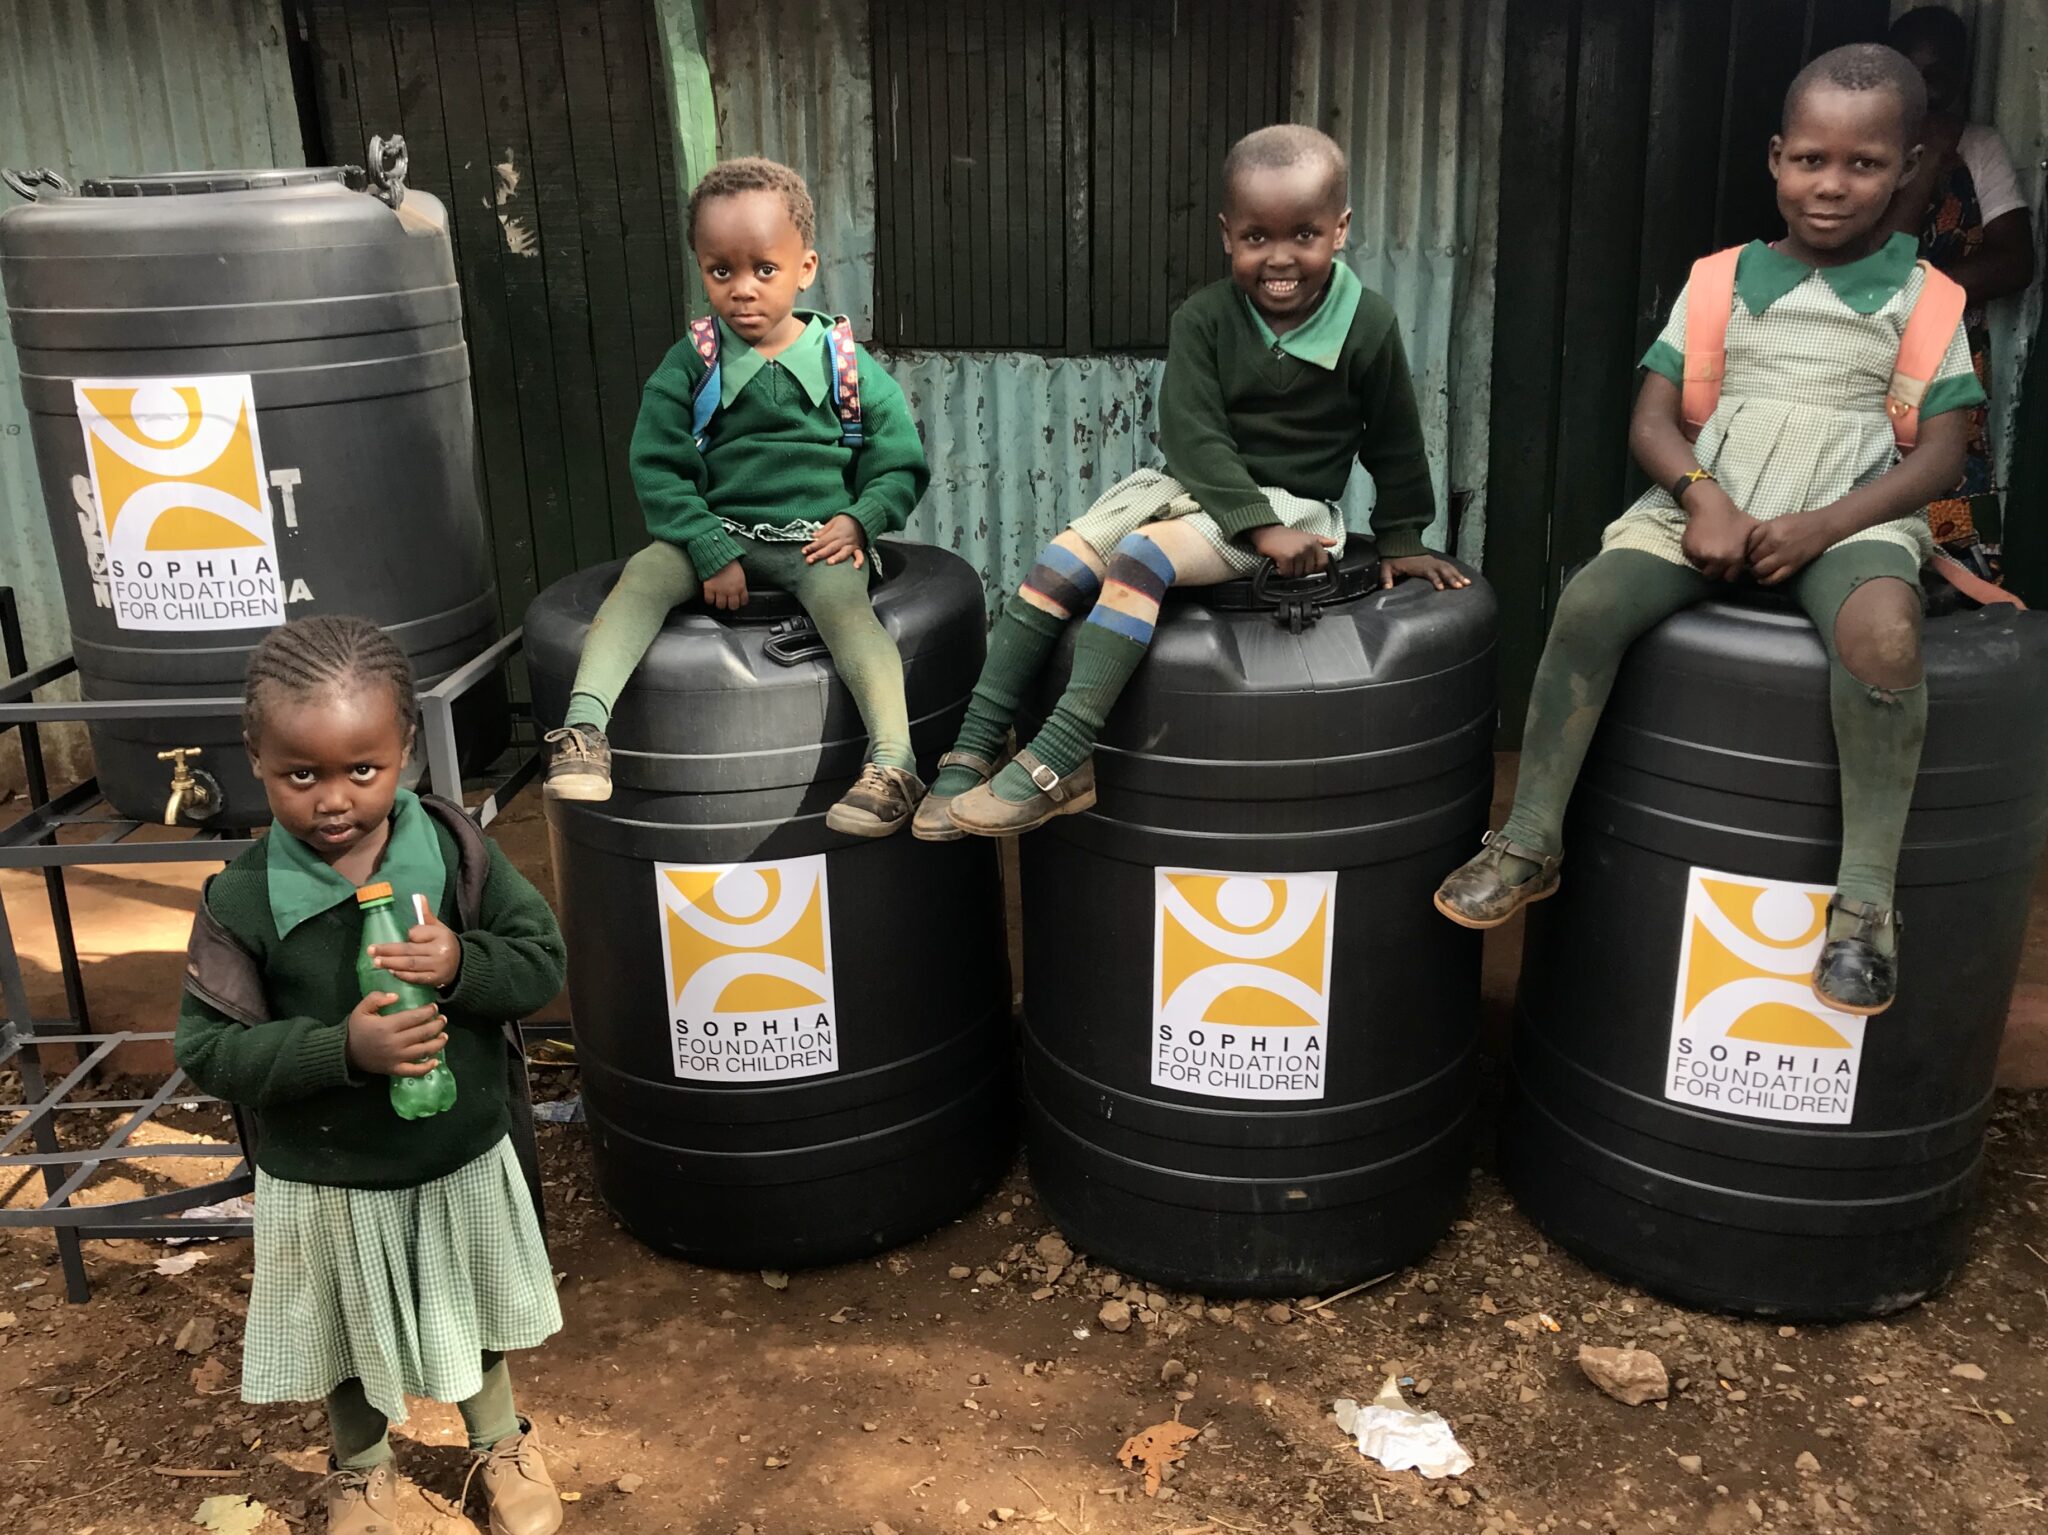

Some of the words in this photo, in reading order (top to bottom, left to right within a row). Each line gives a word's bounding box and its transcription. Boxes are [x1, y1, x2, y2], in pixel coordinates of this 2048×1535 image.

[113, 557, 272, 578] SOPHIA
[116, 577, 276, 600] FOUNDATION
[120, 602, 158, 620] FOR
[164, 598, 278, 621] CHILDREN
[676, 1012, 829, 1037] SOPHIA
[678, 1030, 831, 1055] FOUNDATION
[1159, 1024, 1320, 1052] SOPHIA
[680, 1055, 720, 1072] FOR
[726, 1049, 832, 1073] CHILDREN
[1159, 1043, 1320, 1072] FOUNDATION
[1678, 1037, 1851, 1075] SOPHIA
[1158, 1062, 1200, 1084] FOR
[1208, 1070, 1319, 1091] CHILDREN
[1676, 1057, 1850, 1095] FOUNDATION
[1674, 1077, 1719, 1101] FOR
[1728, 1087, 1847, 1113] CHILDREN
